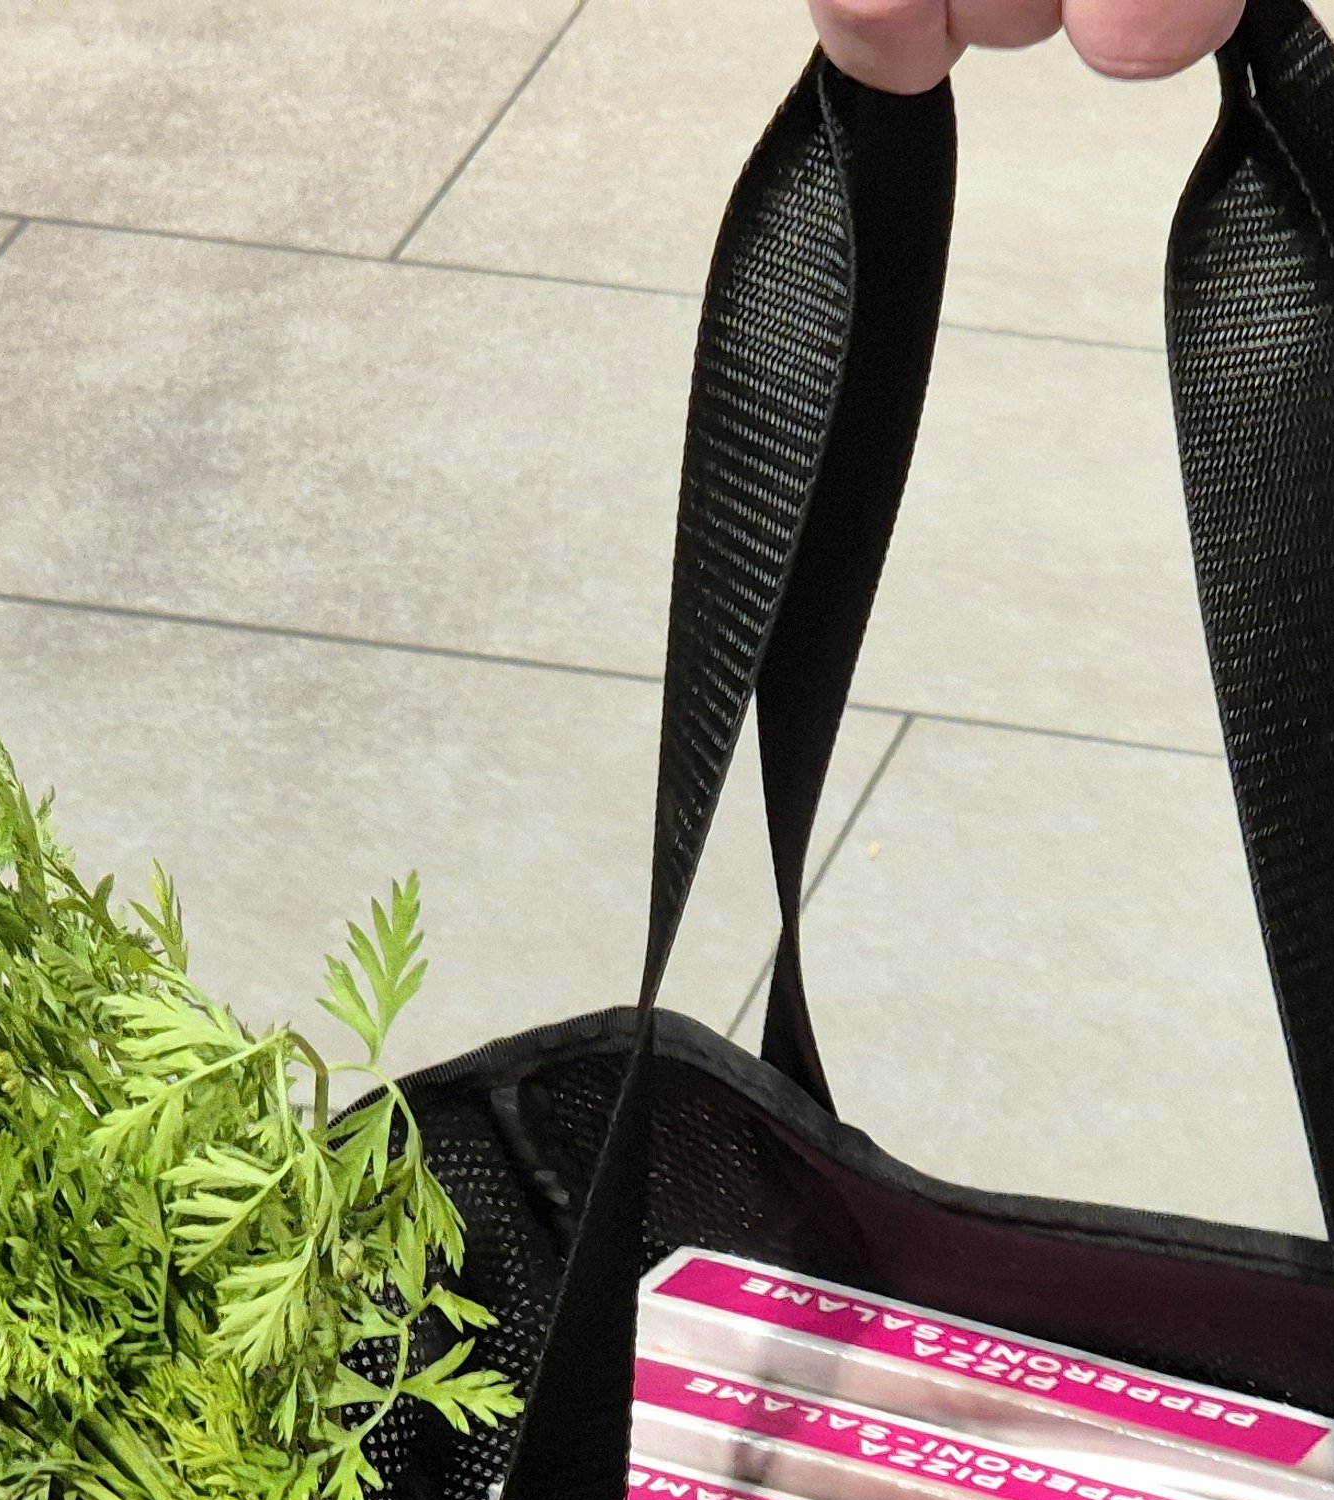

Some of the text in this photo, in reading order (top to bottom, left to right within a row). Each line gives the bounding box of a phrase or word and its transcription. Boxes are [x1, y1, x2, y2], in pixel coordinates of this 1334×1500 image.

[740, 1277, 1260, 1428] PEPPERONI-SALAME
[912, 1338, 1058, 1391] PIZZA
[859, 1439, 1007, 1490] PIZZA
